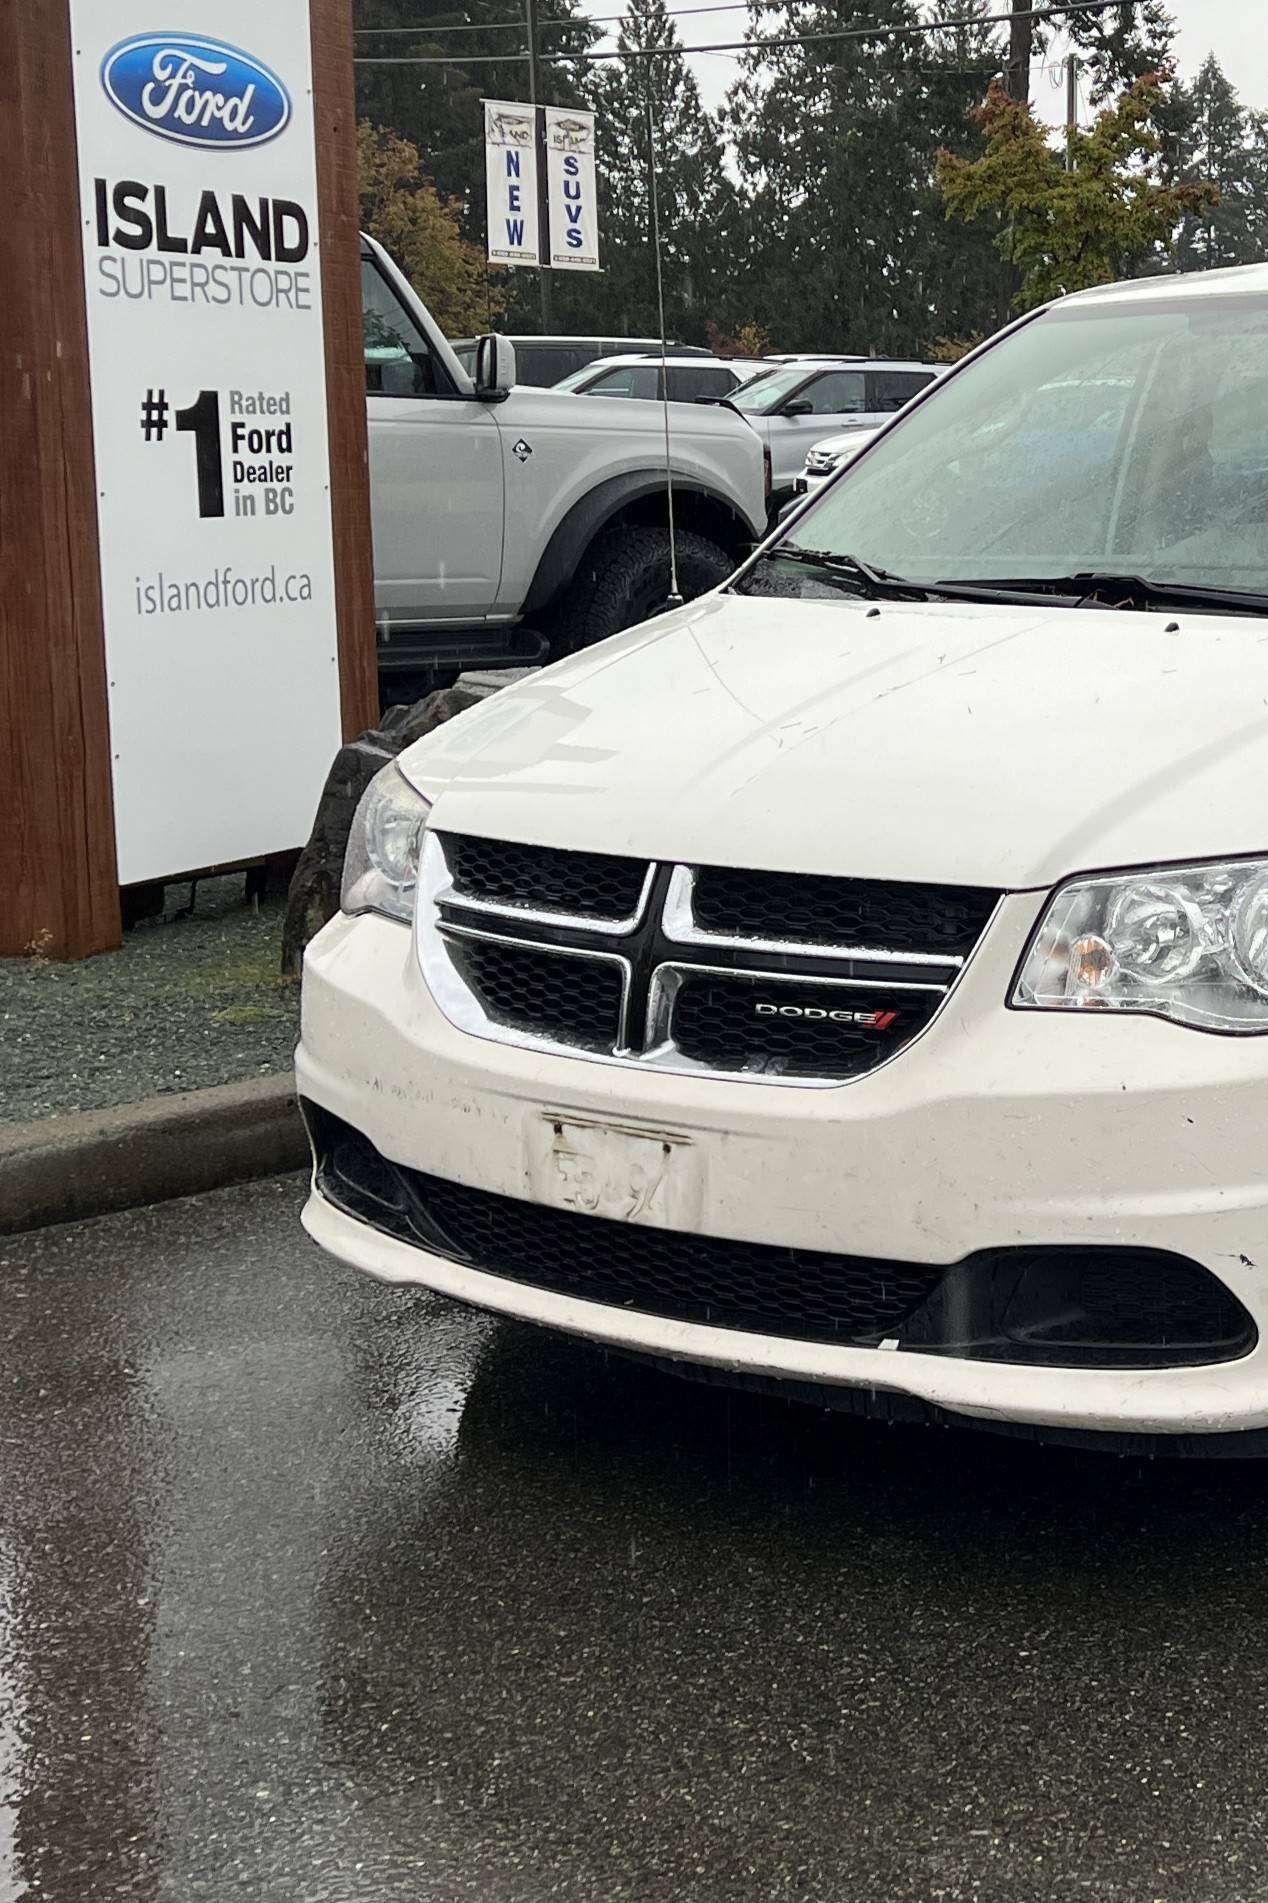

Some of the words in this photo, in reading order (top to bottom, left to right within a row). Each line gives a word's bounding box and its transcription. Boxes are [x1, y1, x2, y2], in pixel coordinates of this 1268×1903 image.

[142, 48, 255, 133] Ford
[94, 177, 309, 263] ISLAND
[505, 150, 524, 246] NEW
[563, 156, 583, 248] SUVS
[98, 255, 312, 310] SUPERSTORE
[229, 390, 290, 415] Rated
[231, 422, 293, 454] Ford
[232, 460, 293, 484] Dealer
[234, 488, 256, 516] in
[264, 487, 294, 516] BC
[136, 565, 312, 614] islandford.ca
[755, 1003, 877, 1024] DODGE
